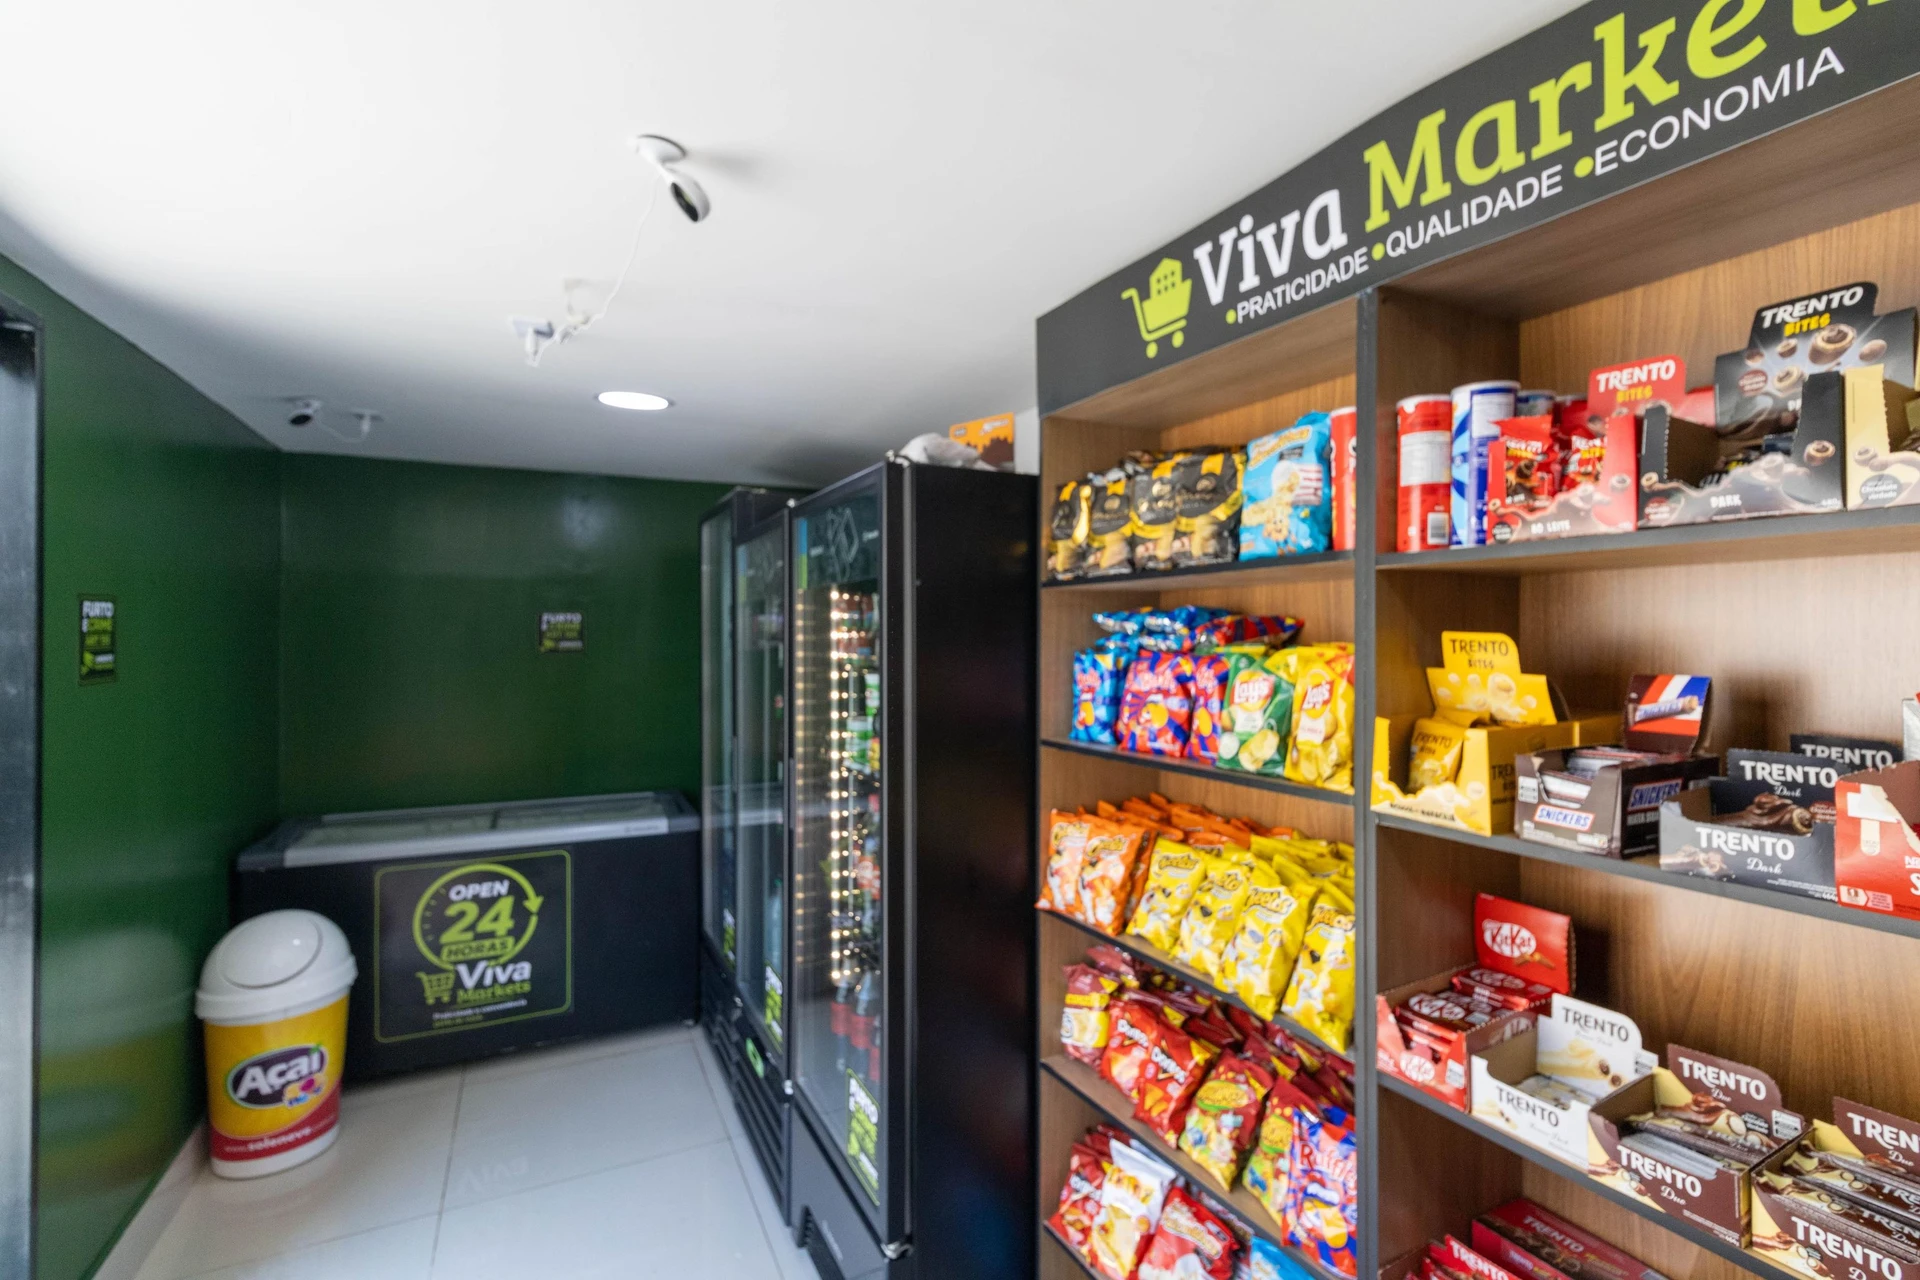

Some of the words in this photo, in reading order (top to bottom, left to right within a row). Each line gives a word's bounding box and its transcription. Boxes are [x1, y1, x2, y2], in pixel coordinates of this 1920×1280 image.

[1193, 188, 1348, 306] Viva
[1363, 0, 1891, 233] Marke
[1237, 246, 1369, 324] PRATICIDADE
[1386, 164, 1563, 258] QUALIDADE
[1594, 46, 1845, 176] ECONOMIA
[1760, 285, 1864, 329] TRENTO
[1784, 312, 1831, 337] BITES
[1596, 359, 1676, 393] TRENTO
[1450, 638, 1509, 656] TRENTO
[1739, 760, 1838, 789] TRENTO
[1773, 784, 1802, 798] Dark
[1538, 807, 1590, 827] SNICKERS
[1696, 827, 1795, 861] TRENTO
[1746, 857, 1783, 875] Dark
[449, 879, 510, 902] OPEN
[439, 895, 515, 944] 24
[455, 960, 532, 990] Viva
[1563, 1007, 1629, 1042] TRENTO
[1678, 1056, 1767, 1101] TRENTO
[1710, 1086, 1732, 1102] Duo
[1496, 1085, 1559, 1127] TRENTO
[1846, 1112, 1920, 1153] TREN
[1616, 1145, 1702, 1198] TRENTO
[1888, 1150, 1914, 1167] Duo
[1660, 1185, 1686, 1205] Duo
[1881, 1183, 1920, 1206] TRE
[1523, 1216, 1585, 1253] TRENTO
[1861, 1209, 1920, 1240] TREN
[1450, 1240, 1509, 1280] TRENTO
[1790, 1215, 1902, 1280] TRENTO
